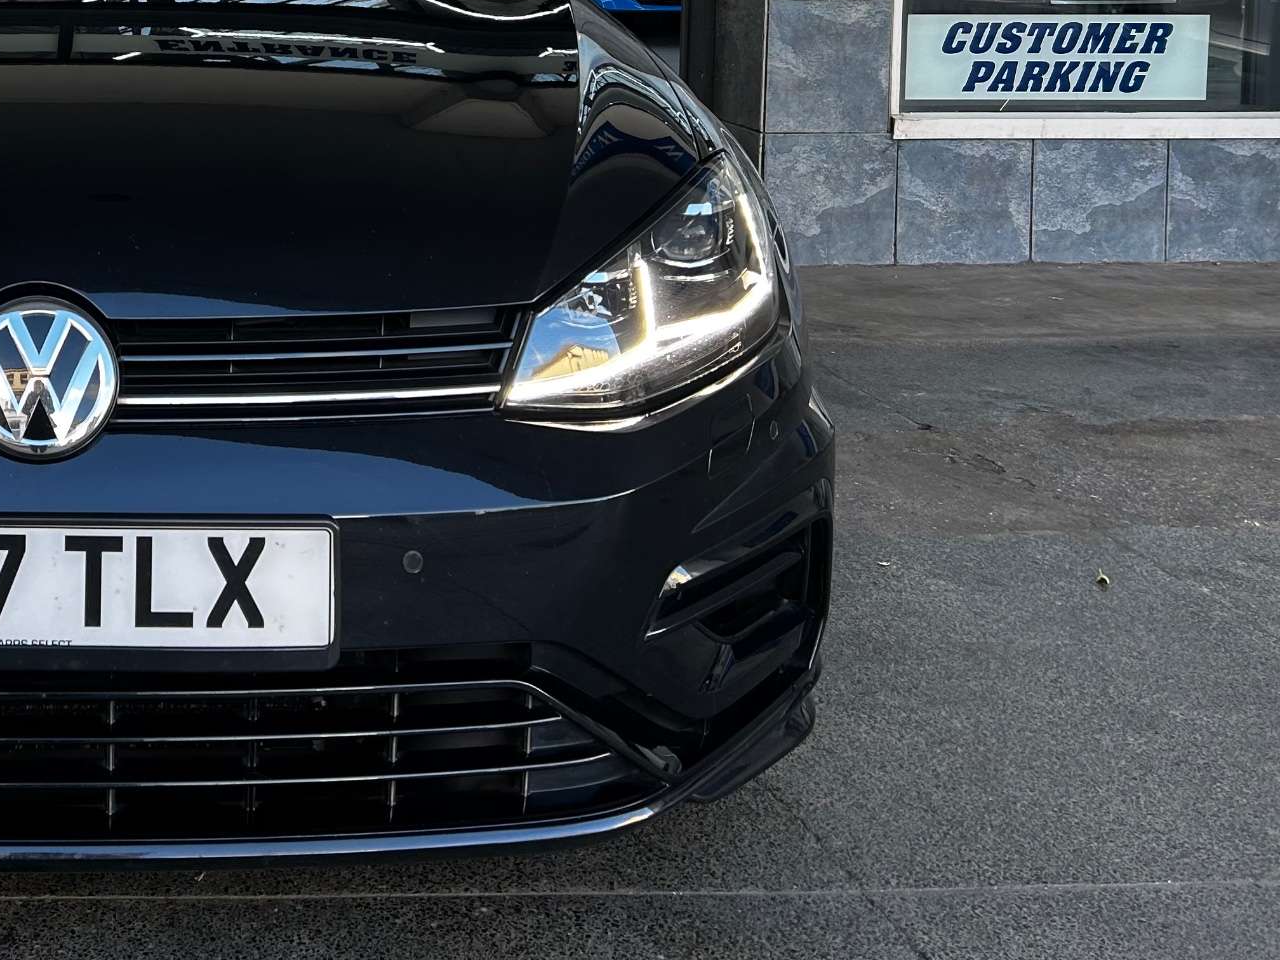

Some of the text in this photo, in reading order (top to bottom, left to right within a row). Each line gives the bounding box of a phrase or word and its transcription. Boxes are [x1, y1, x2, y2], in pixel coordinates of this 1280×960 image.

[941, 21, 1174, 56] CUSTOMER
[961, 60, 1151, 95] PARKING
[64, 535, 266, 629] TLX
